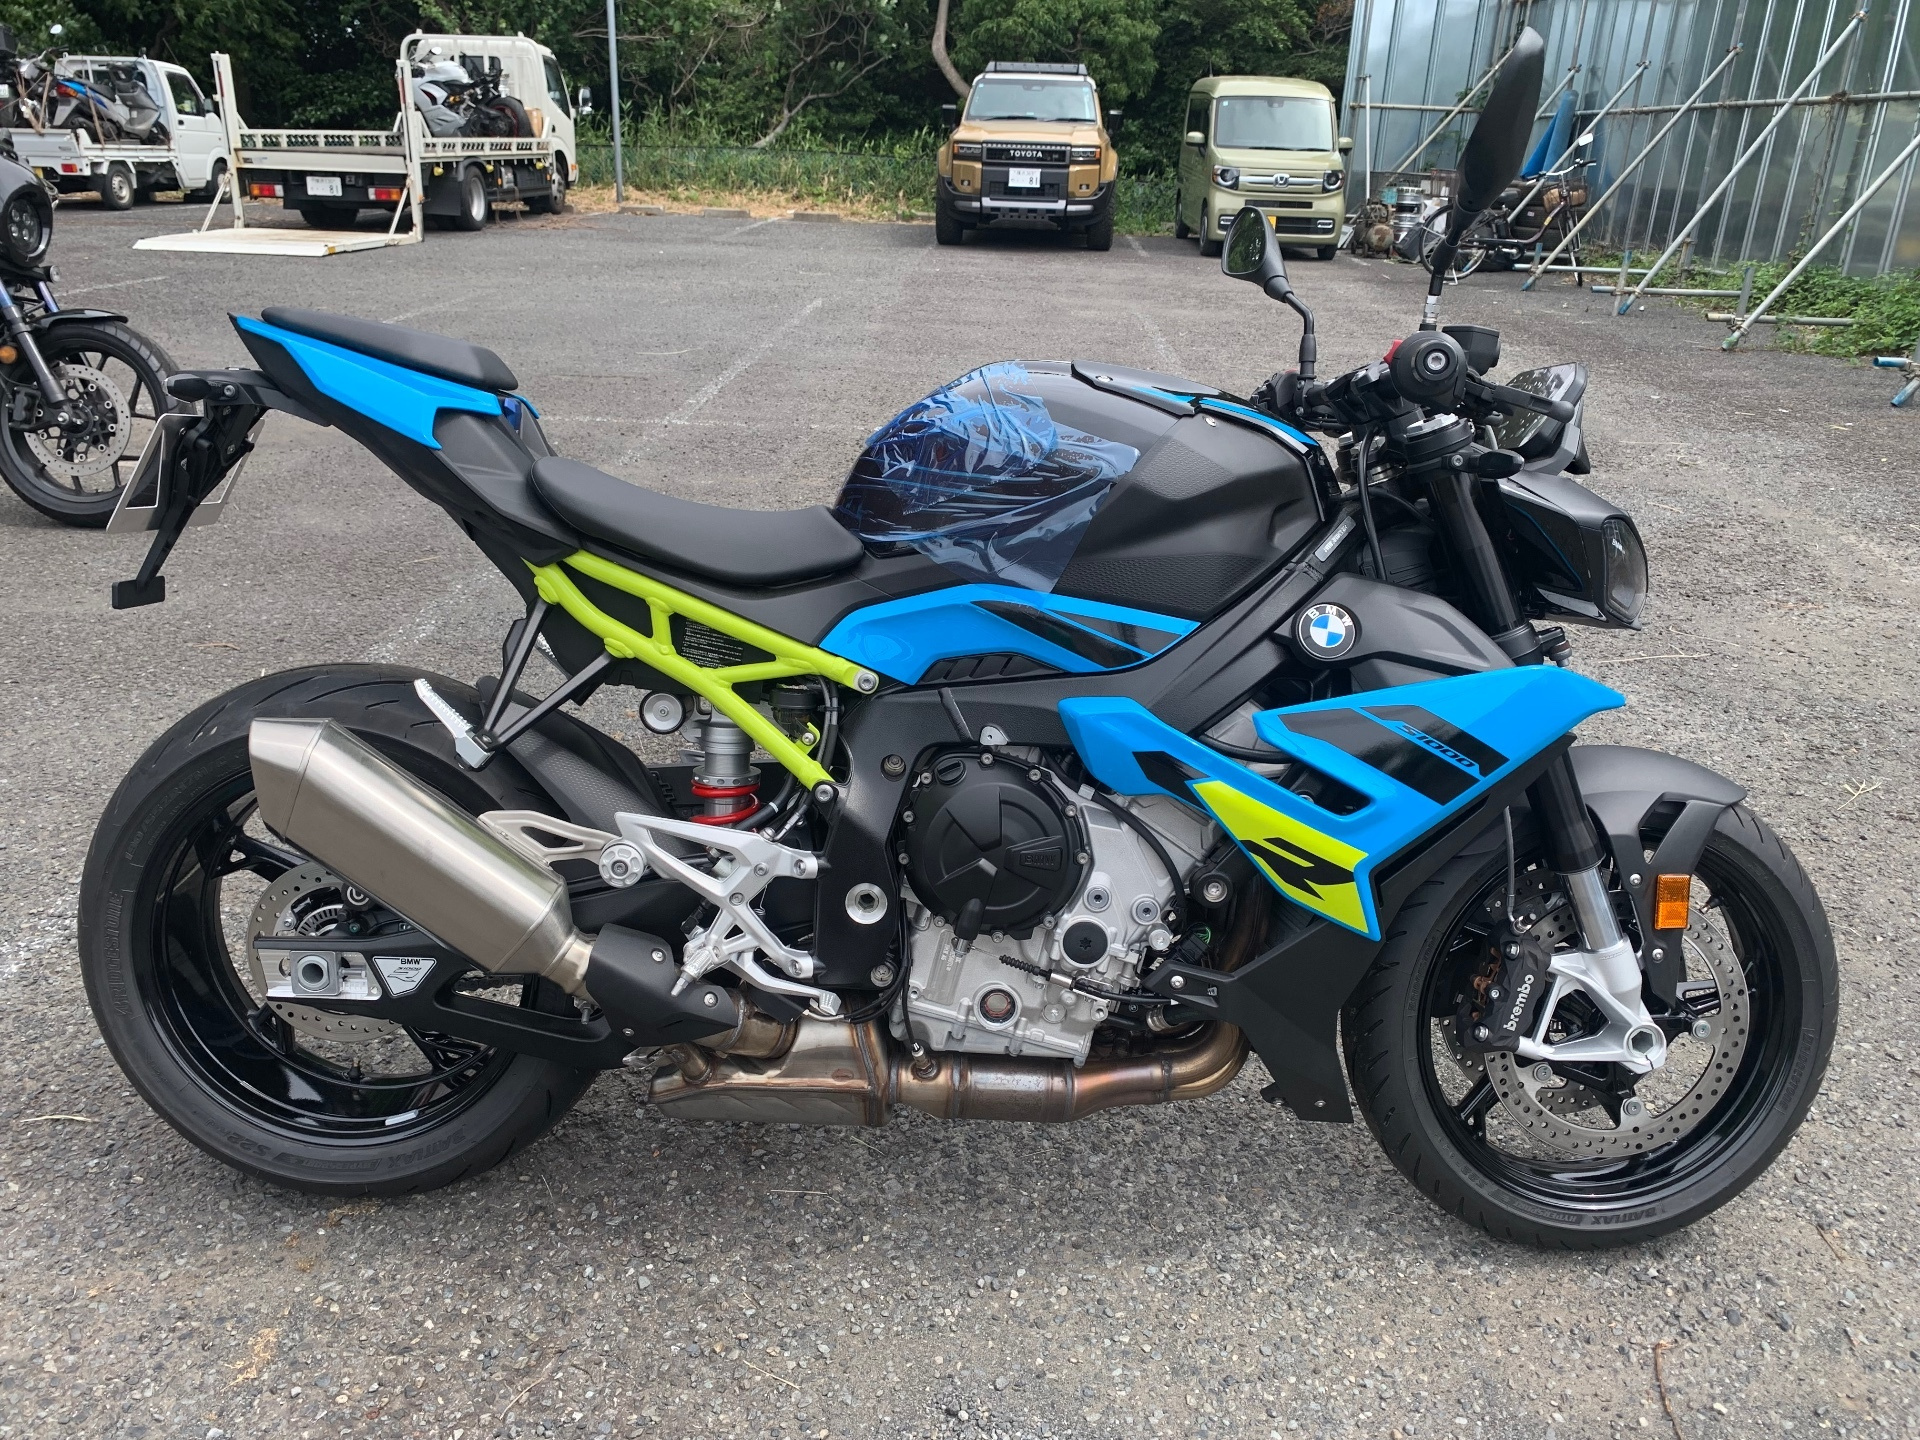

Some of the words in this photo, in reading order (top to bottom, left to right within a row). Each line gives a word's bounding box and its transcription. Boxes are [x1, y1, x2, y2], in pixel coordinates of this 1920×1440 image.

[1009, 150, 1043, 158] TOYOTA
[1029, 176, 1039, 186] 81
[1307, 604, 1354, 627] BMW
[1396, 723, 1476, 768] S1000
[104, 890, 132, 1016] BRIDGESTONE
[1503, 974, 1535, 1032] brembo
[1590, 1207, 1657, 1226] BATTLAX
